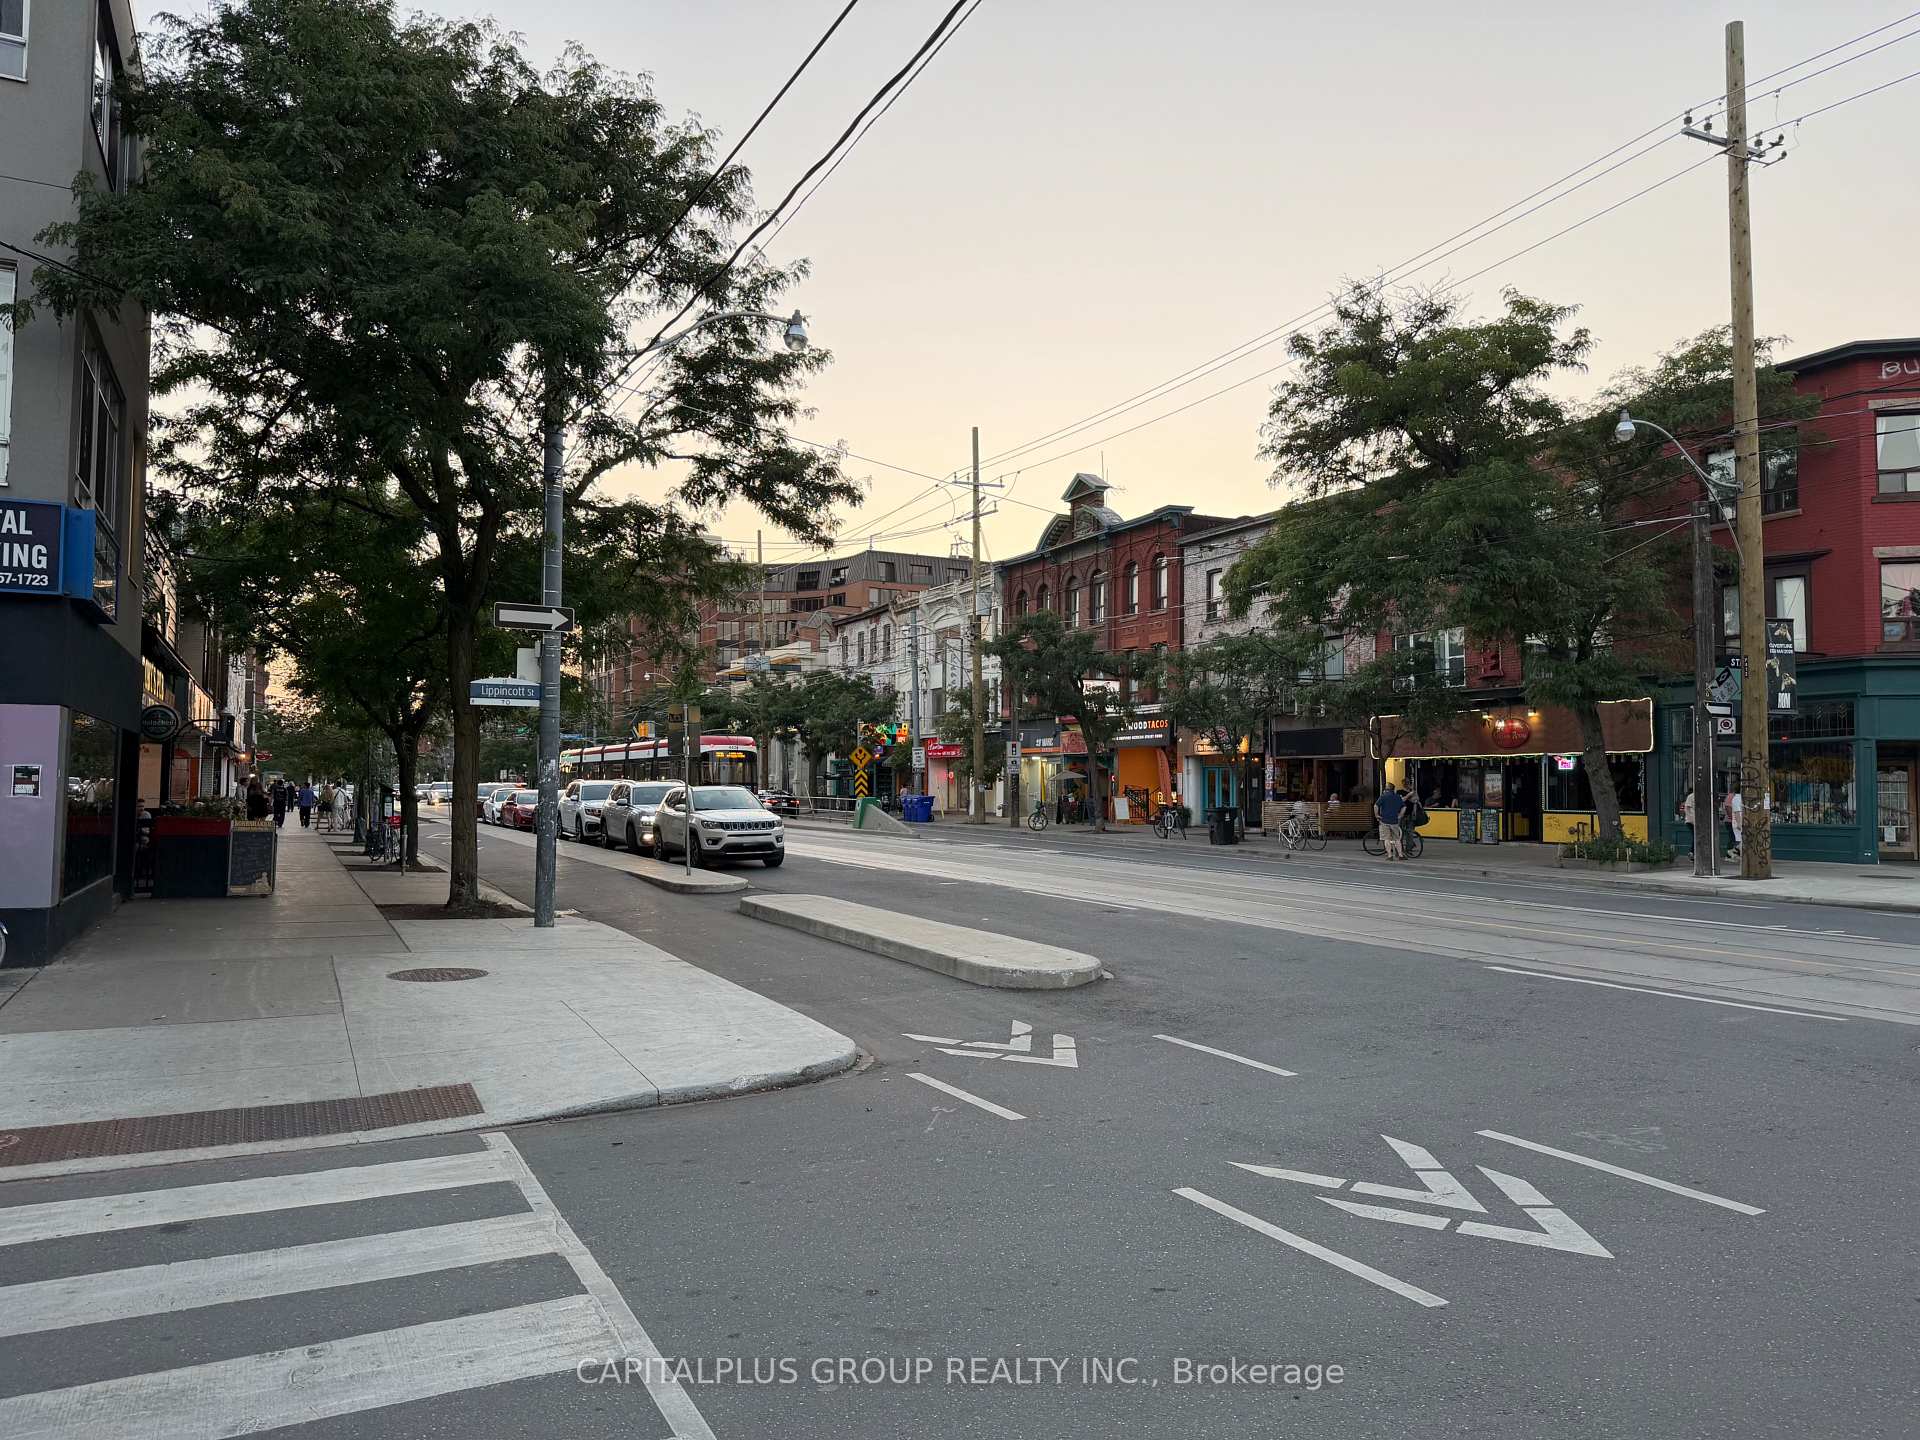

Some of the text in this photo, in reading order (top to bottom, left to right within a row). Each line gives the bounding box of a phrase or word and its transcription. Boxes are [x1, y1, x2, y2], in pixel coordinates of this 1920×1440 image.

[0, 542, 48, 569] ING
[1730, 658, 1742, 667] ST
[481, 684, 535, 698] Lippincott St
